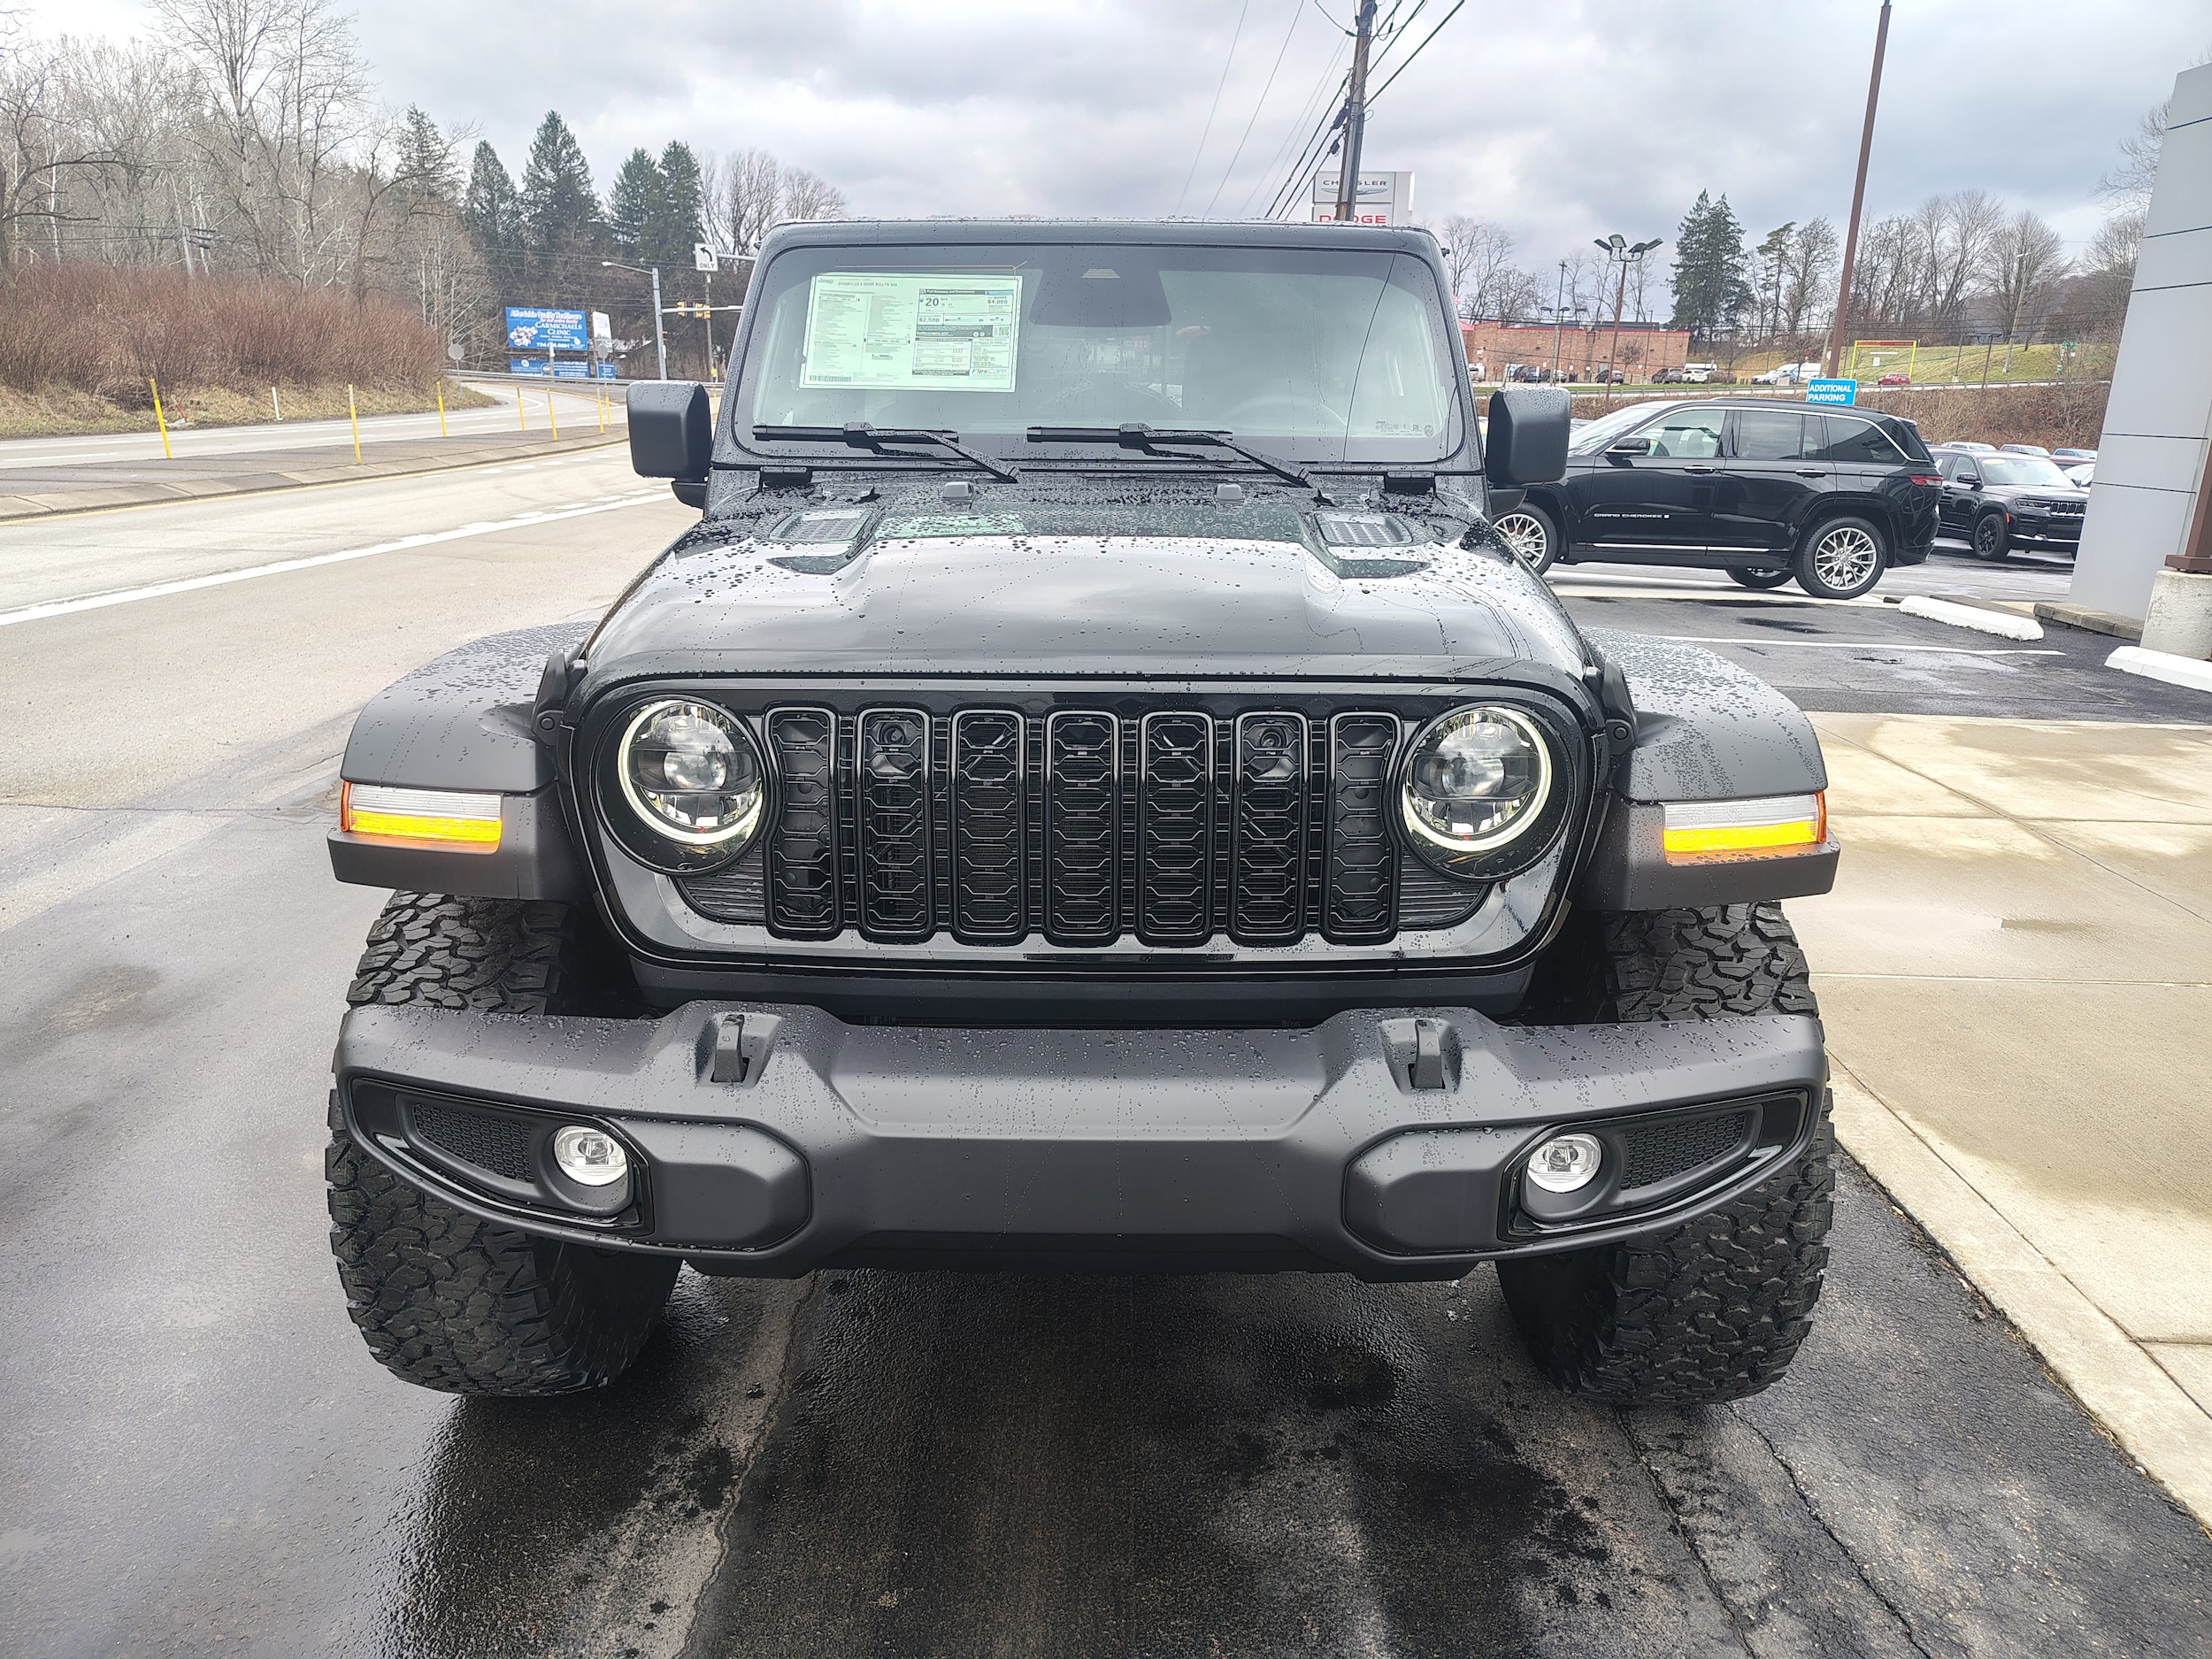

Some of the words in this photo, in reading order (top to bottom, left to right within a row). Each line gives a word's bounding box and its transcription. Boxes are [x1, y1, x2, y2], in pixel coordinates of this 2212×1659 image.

[1319, 215, 1387, 224] DGE
[926, 297, 939, 306] 20
[1809, 384, 1852, 393] ADDITIONAL
[1808, 393, 1846, 402] PARKING
